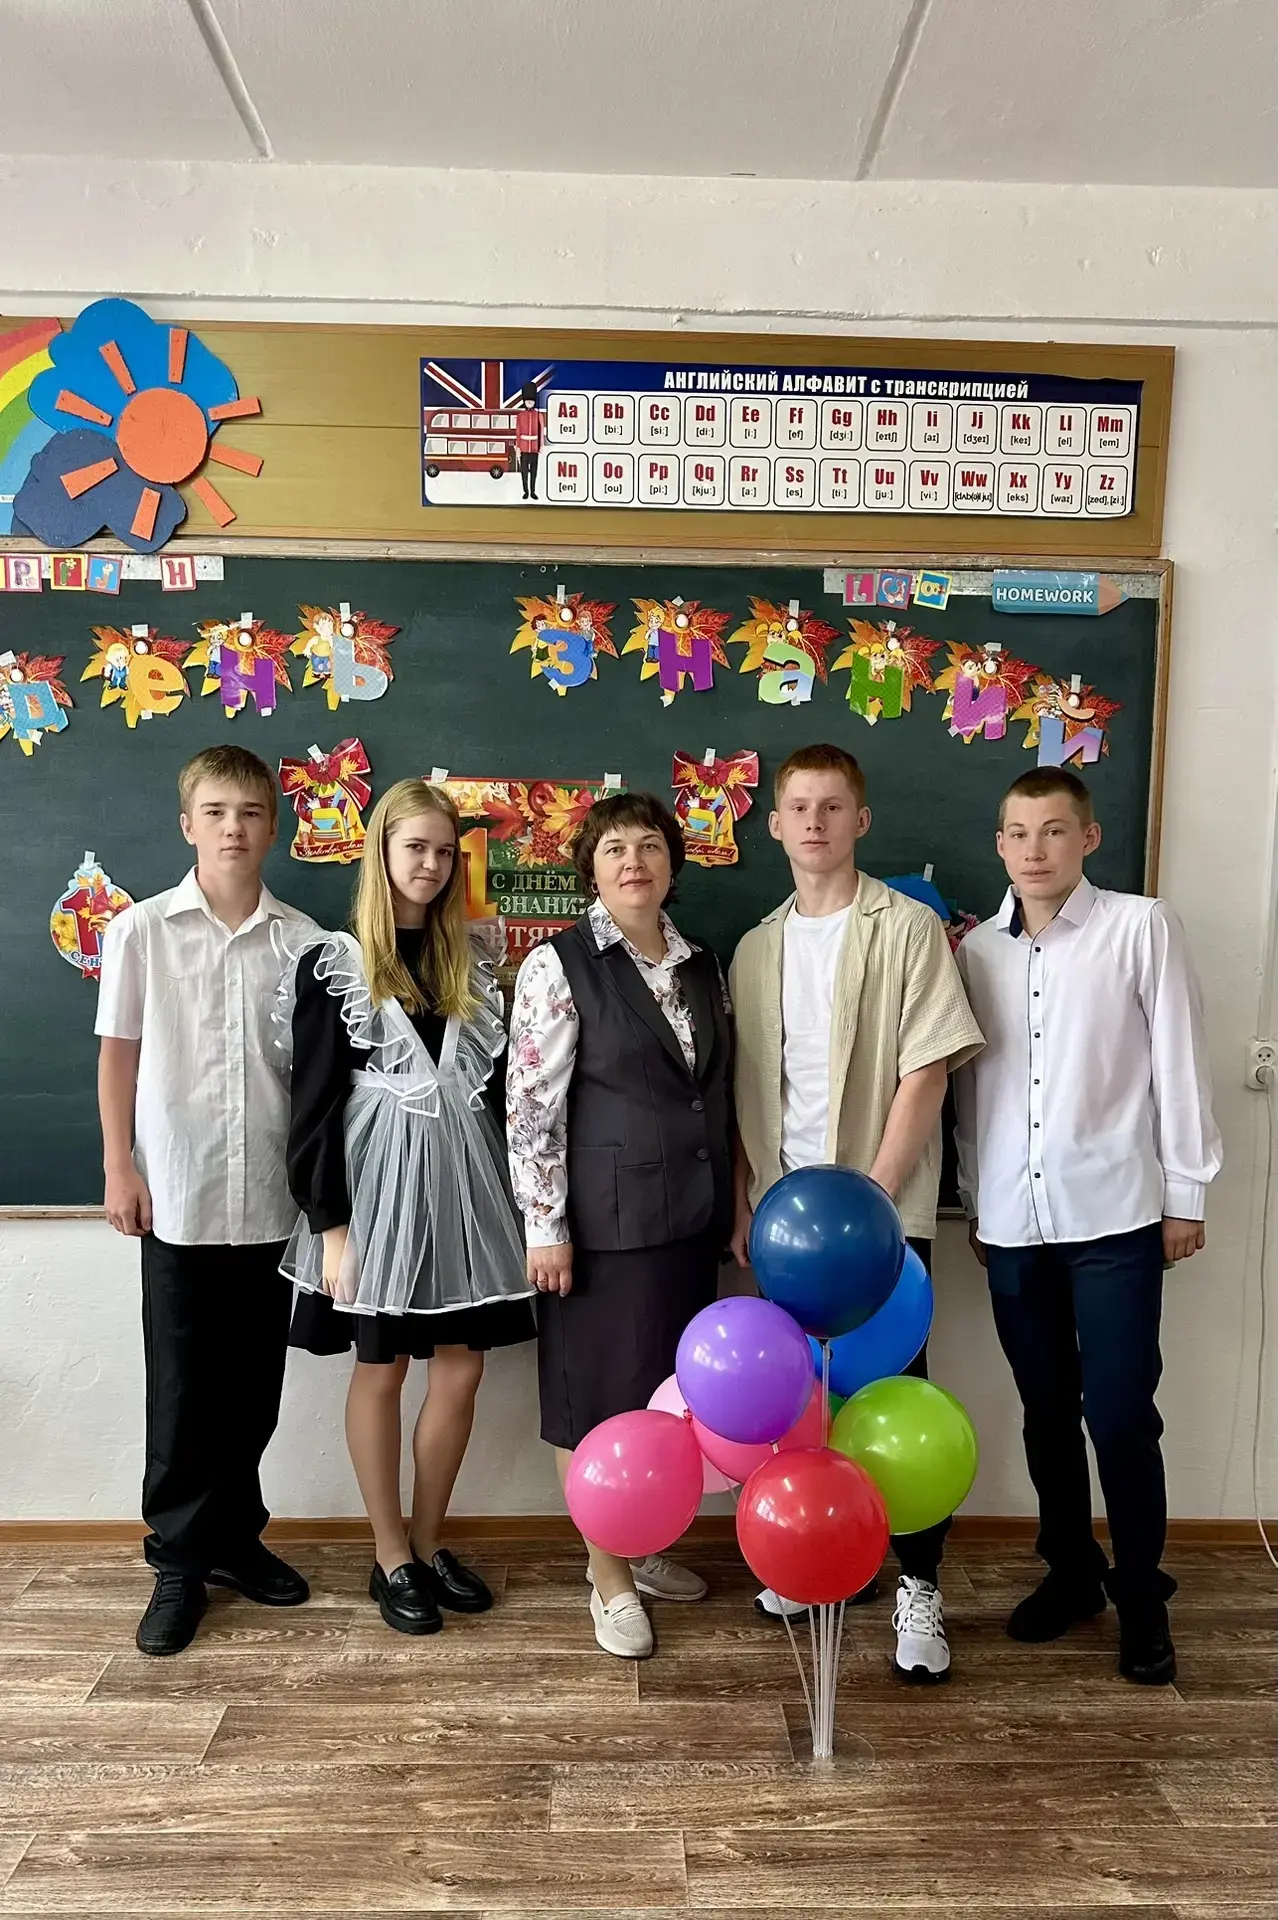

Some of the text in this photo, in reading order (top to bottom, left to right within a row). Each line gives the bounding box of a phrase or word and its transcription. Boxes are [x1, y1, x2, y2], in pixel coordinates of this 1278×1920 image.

[664, 370, 1029, 400] АНГЛИЙСКИЙ АЛФАВИТ с транскрипцией
[558, 402, 578, 419] Aa
[604, 403, 624, 419] Bb
[649, 404, 670, 421] Cc
[695, 405, 716, 422] Dd
[742, 406, 760, 422] Ee
[789, 407, 804, 424] Ff
[831, 408, 853, 427] Gg
[877, 409, 898, 426] Hh
[926, 411, 938, 427] Ii
[971, 412, 983, 429] Jj
[1011, 413, 1031, 430] Kk
[1097, 416, 1123, 432] Mm
[789, 430, 804, 441] [ef]
[1099, 438, 1119, 448] [em]
[557, 461, 1115, 490] Nn Oo Pp Qq Rr Ss Tt Uu Vv Ww Xx Yy Zz
[558, 482, 577, 494] [en]
[786, 488, 803, 499] [es]
[1007, 493, 1029, 504] [eks]
[996, 587, 1095, 605] HOMEWORK
[491, 870, 577, 893] С ДНЁМ
[61, 886, 101, 957] 1
[70, 951, 103, 968] СЕН
